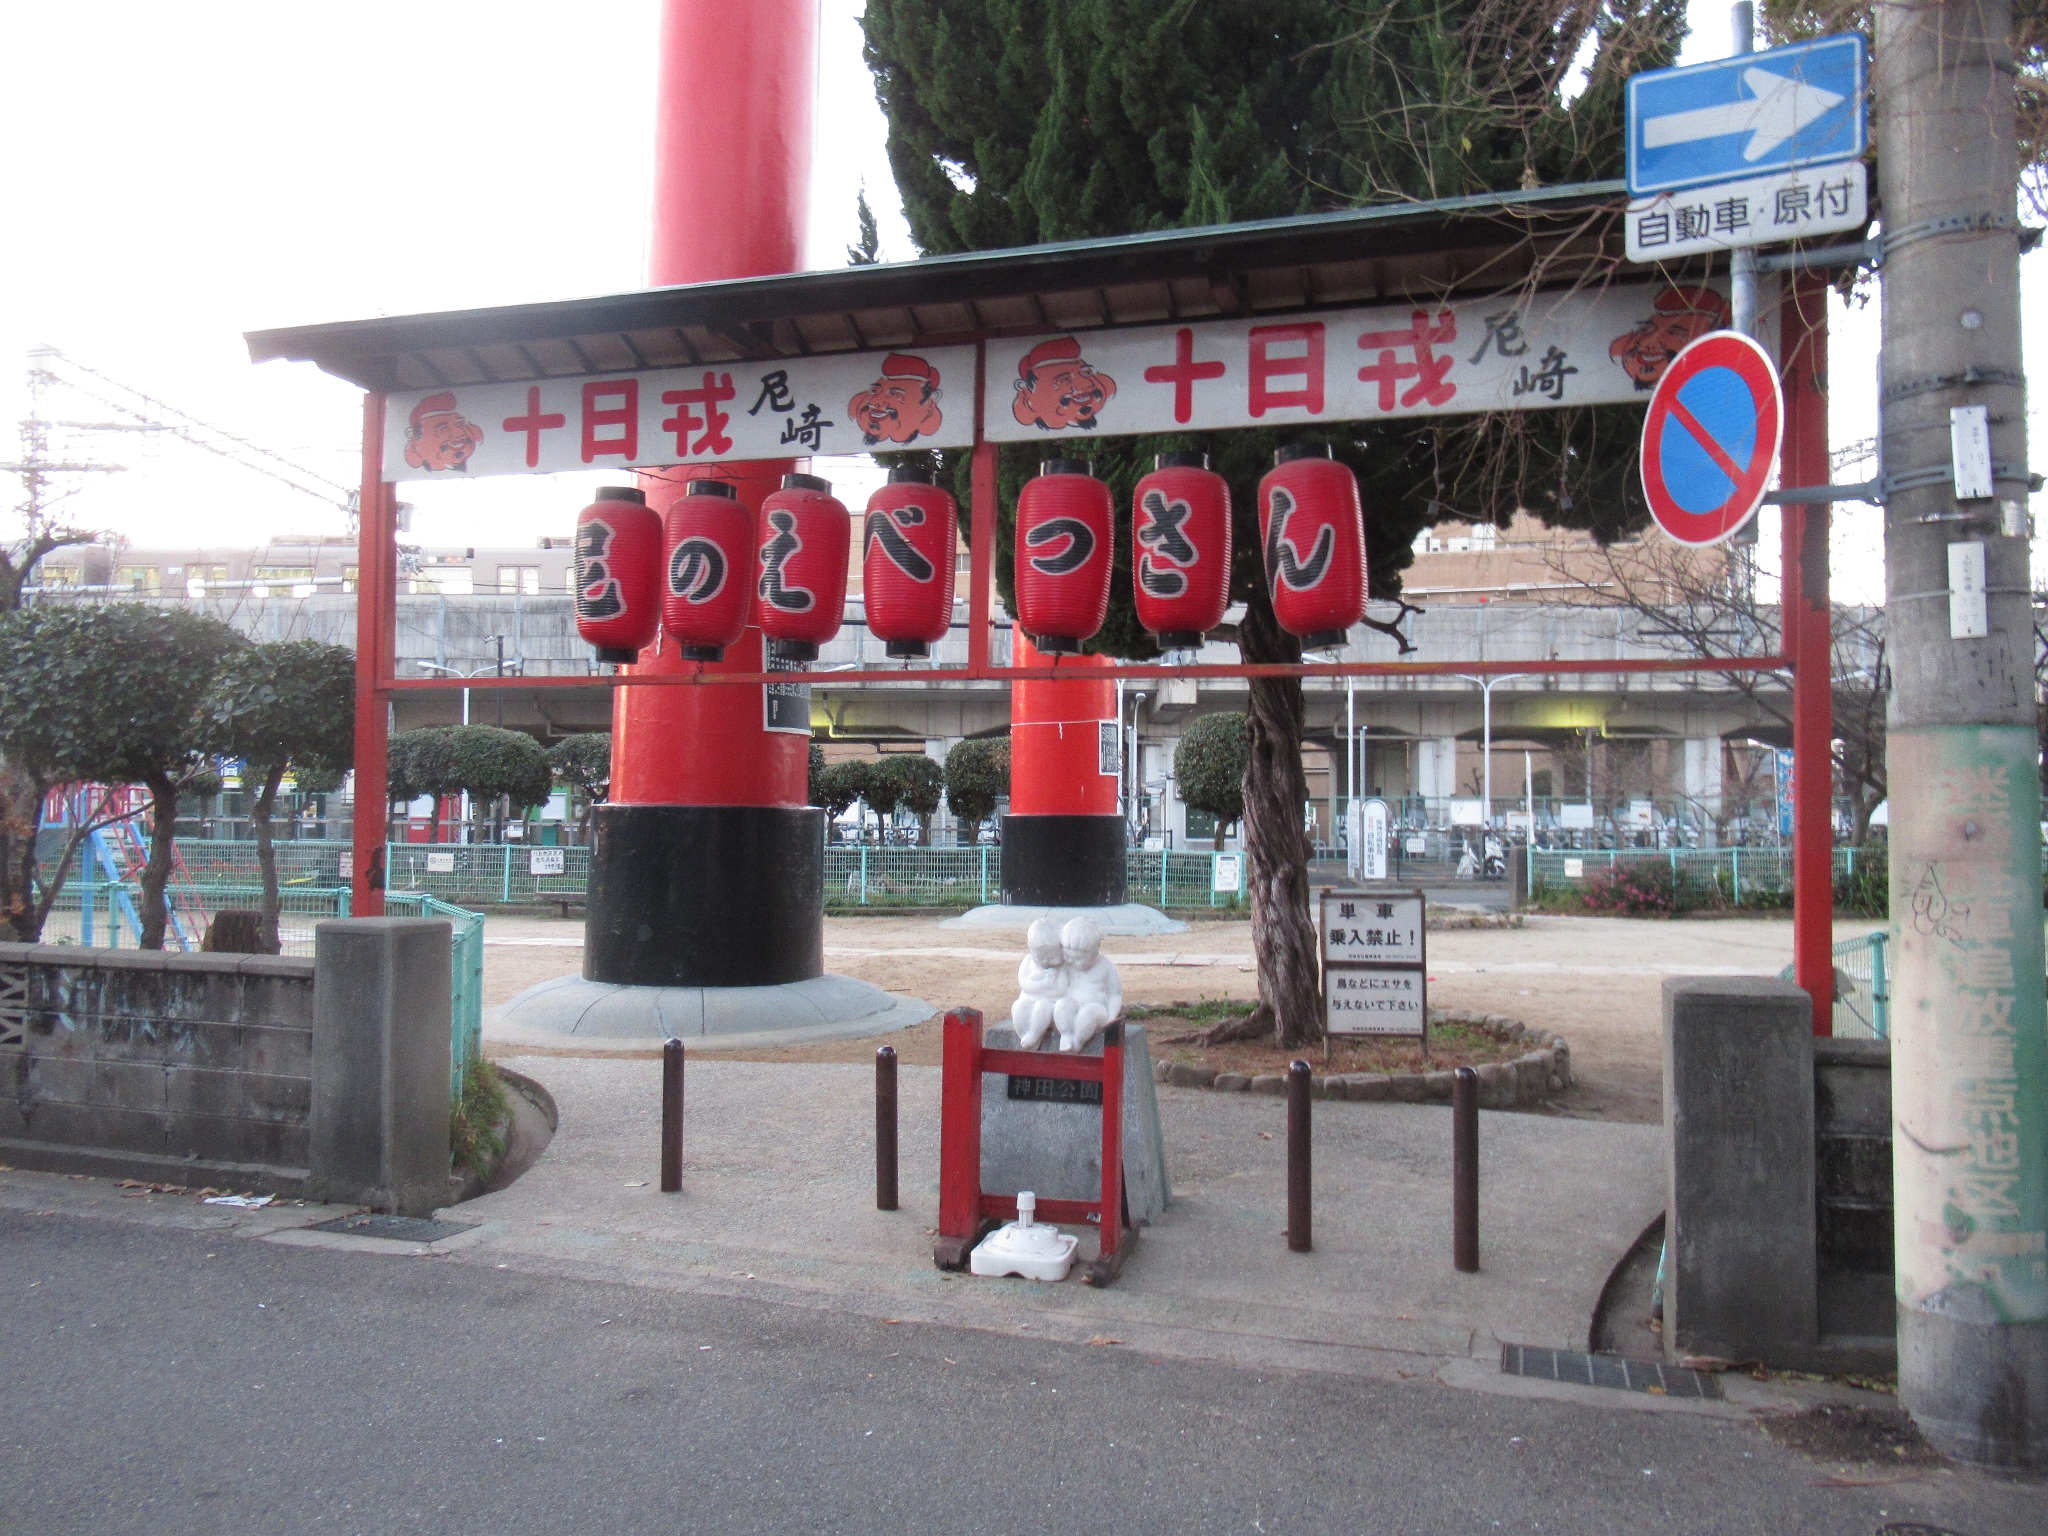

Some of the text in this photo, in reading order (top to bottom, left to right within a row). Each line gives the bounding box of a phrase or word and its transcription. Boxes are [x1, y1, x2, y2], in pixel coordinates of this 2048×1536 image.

[1638, 178, 1854, 248] 自動車・原付
[1144, 309, 1579, 424] 十日戎 尼崎
[502, 370, 834, 467] 十日戎 尼崎
[669, 536, 728, 604] の
[758, 509, 815, 613] え
[1138, 489, 1199, 598] さ
[1264, 486, 1335, 604] ん
[1340, 902, 1394, 920] 単車
[1331, 999, 1418, 1011] 与えないで下さい
[1336, 978, 1411, 990] 鳥などにエサを
